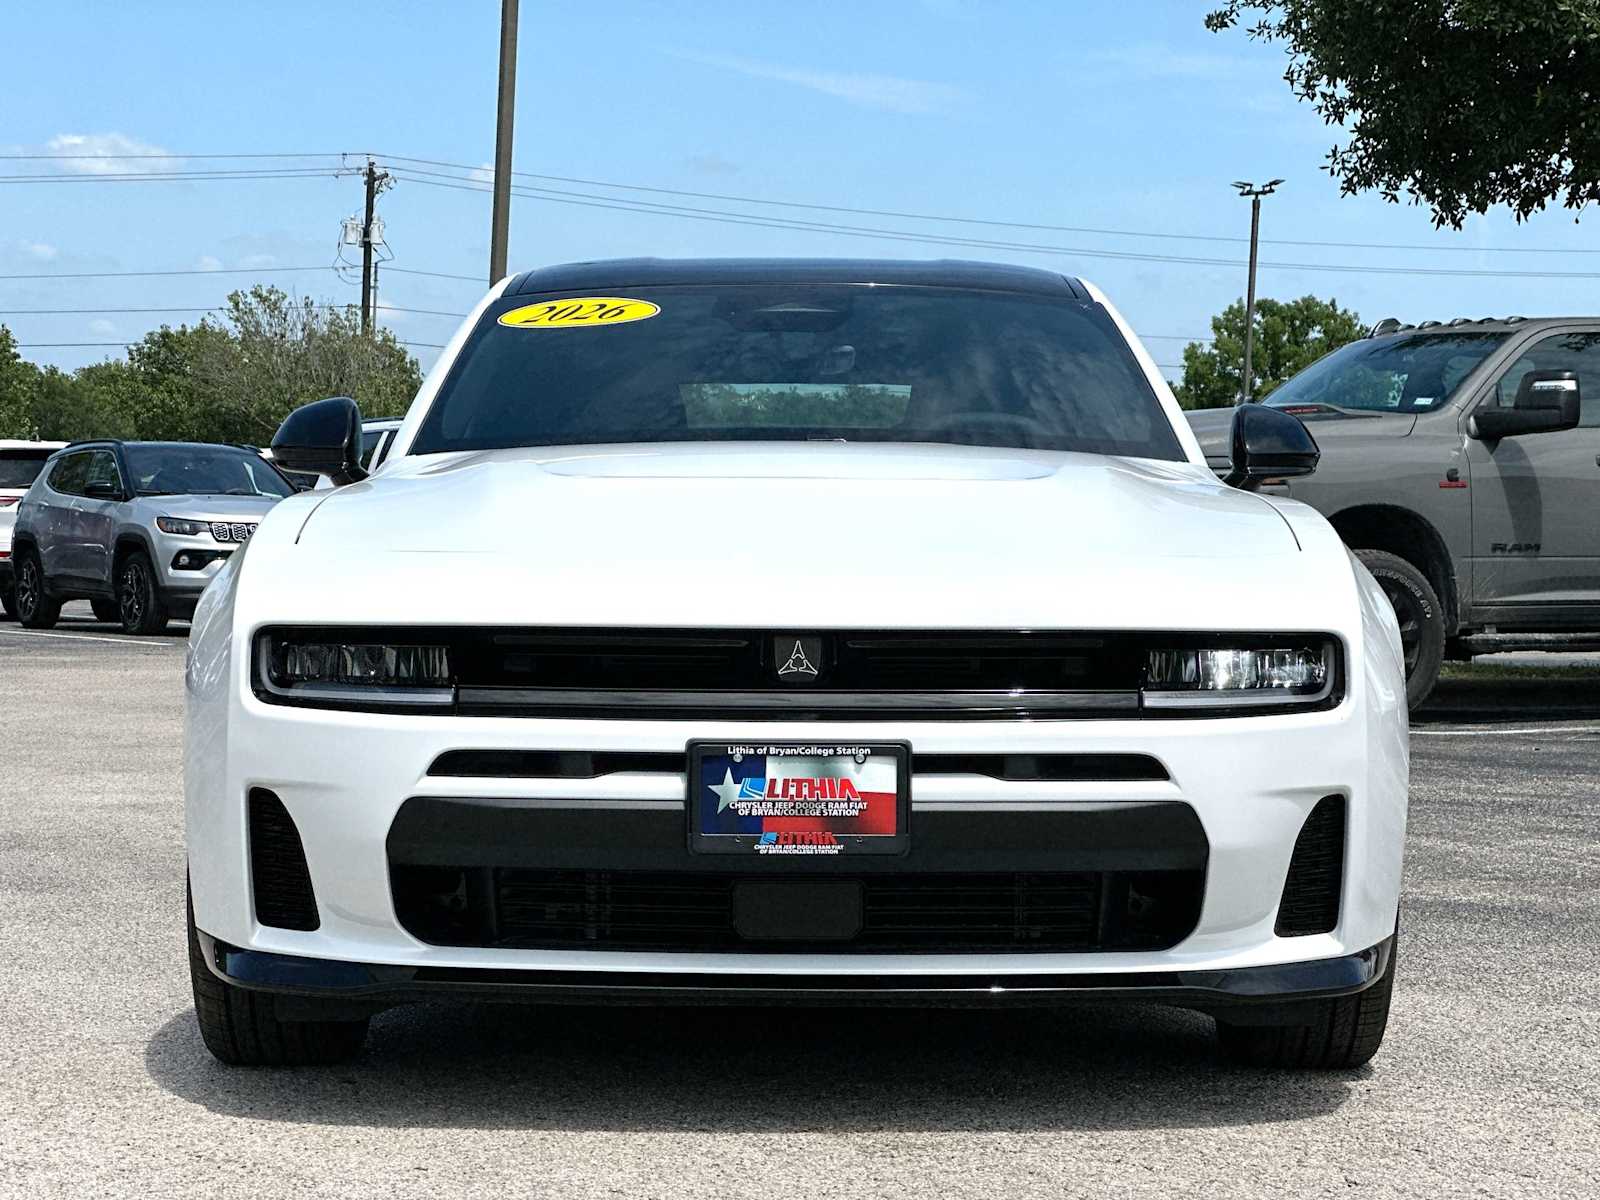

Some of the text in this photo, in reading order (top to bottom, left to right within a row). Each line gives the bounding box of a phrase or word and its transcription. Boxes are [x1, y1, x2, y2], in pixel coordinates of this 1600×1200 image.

[520, 303, 632, 323] 2026
[1491, 543, 1541, 553] RAM
[727, 746, 871, 757] Lithia of Bryan/College Station
[765, 777, 861, 800] LITHIA
[729, 801, 868, 810] CHRYSLER JEEP DODGE RAM FIAT
[738, 808, 859, 817] OF BRYAN/COLLEGE STATION
[777, 831, 839, 845] LITHIA
